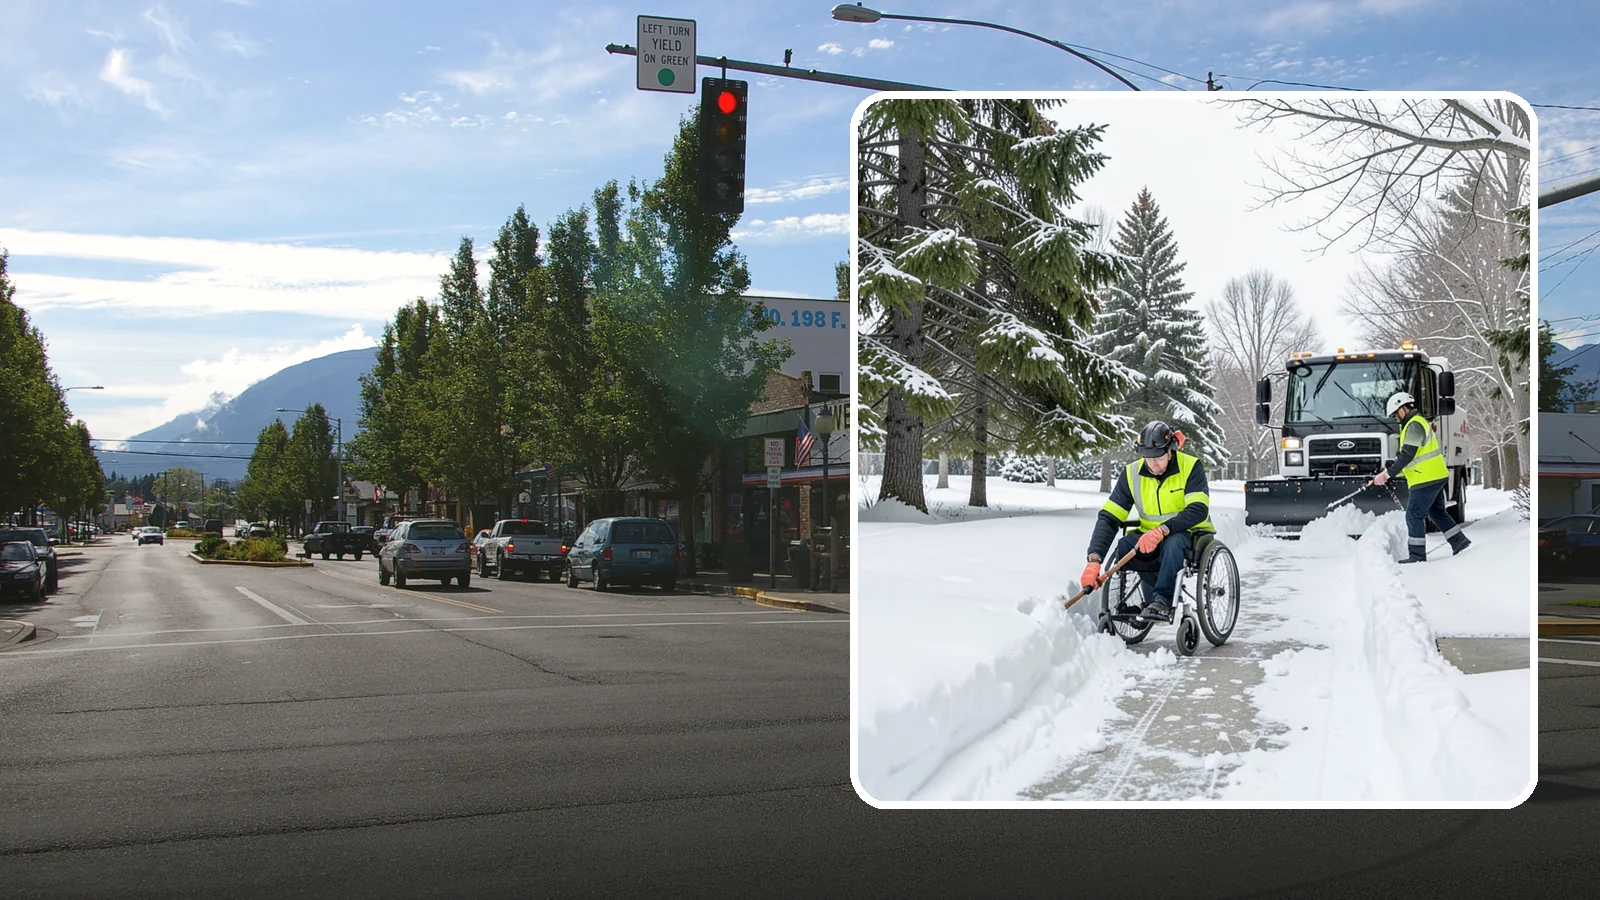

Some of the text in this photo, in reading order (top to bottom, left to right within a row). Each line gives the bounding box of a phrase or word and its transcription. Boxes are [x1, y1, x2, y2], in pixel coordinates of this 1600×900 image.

[643, 24, 690, 36] LEFT TURN
[652, 38, 682, 52] YIELD
[644, 53, 689, 66] ON GREEN
[791, 309, 826, 328] 198
[831, 311, 846, 329] F.
